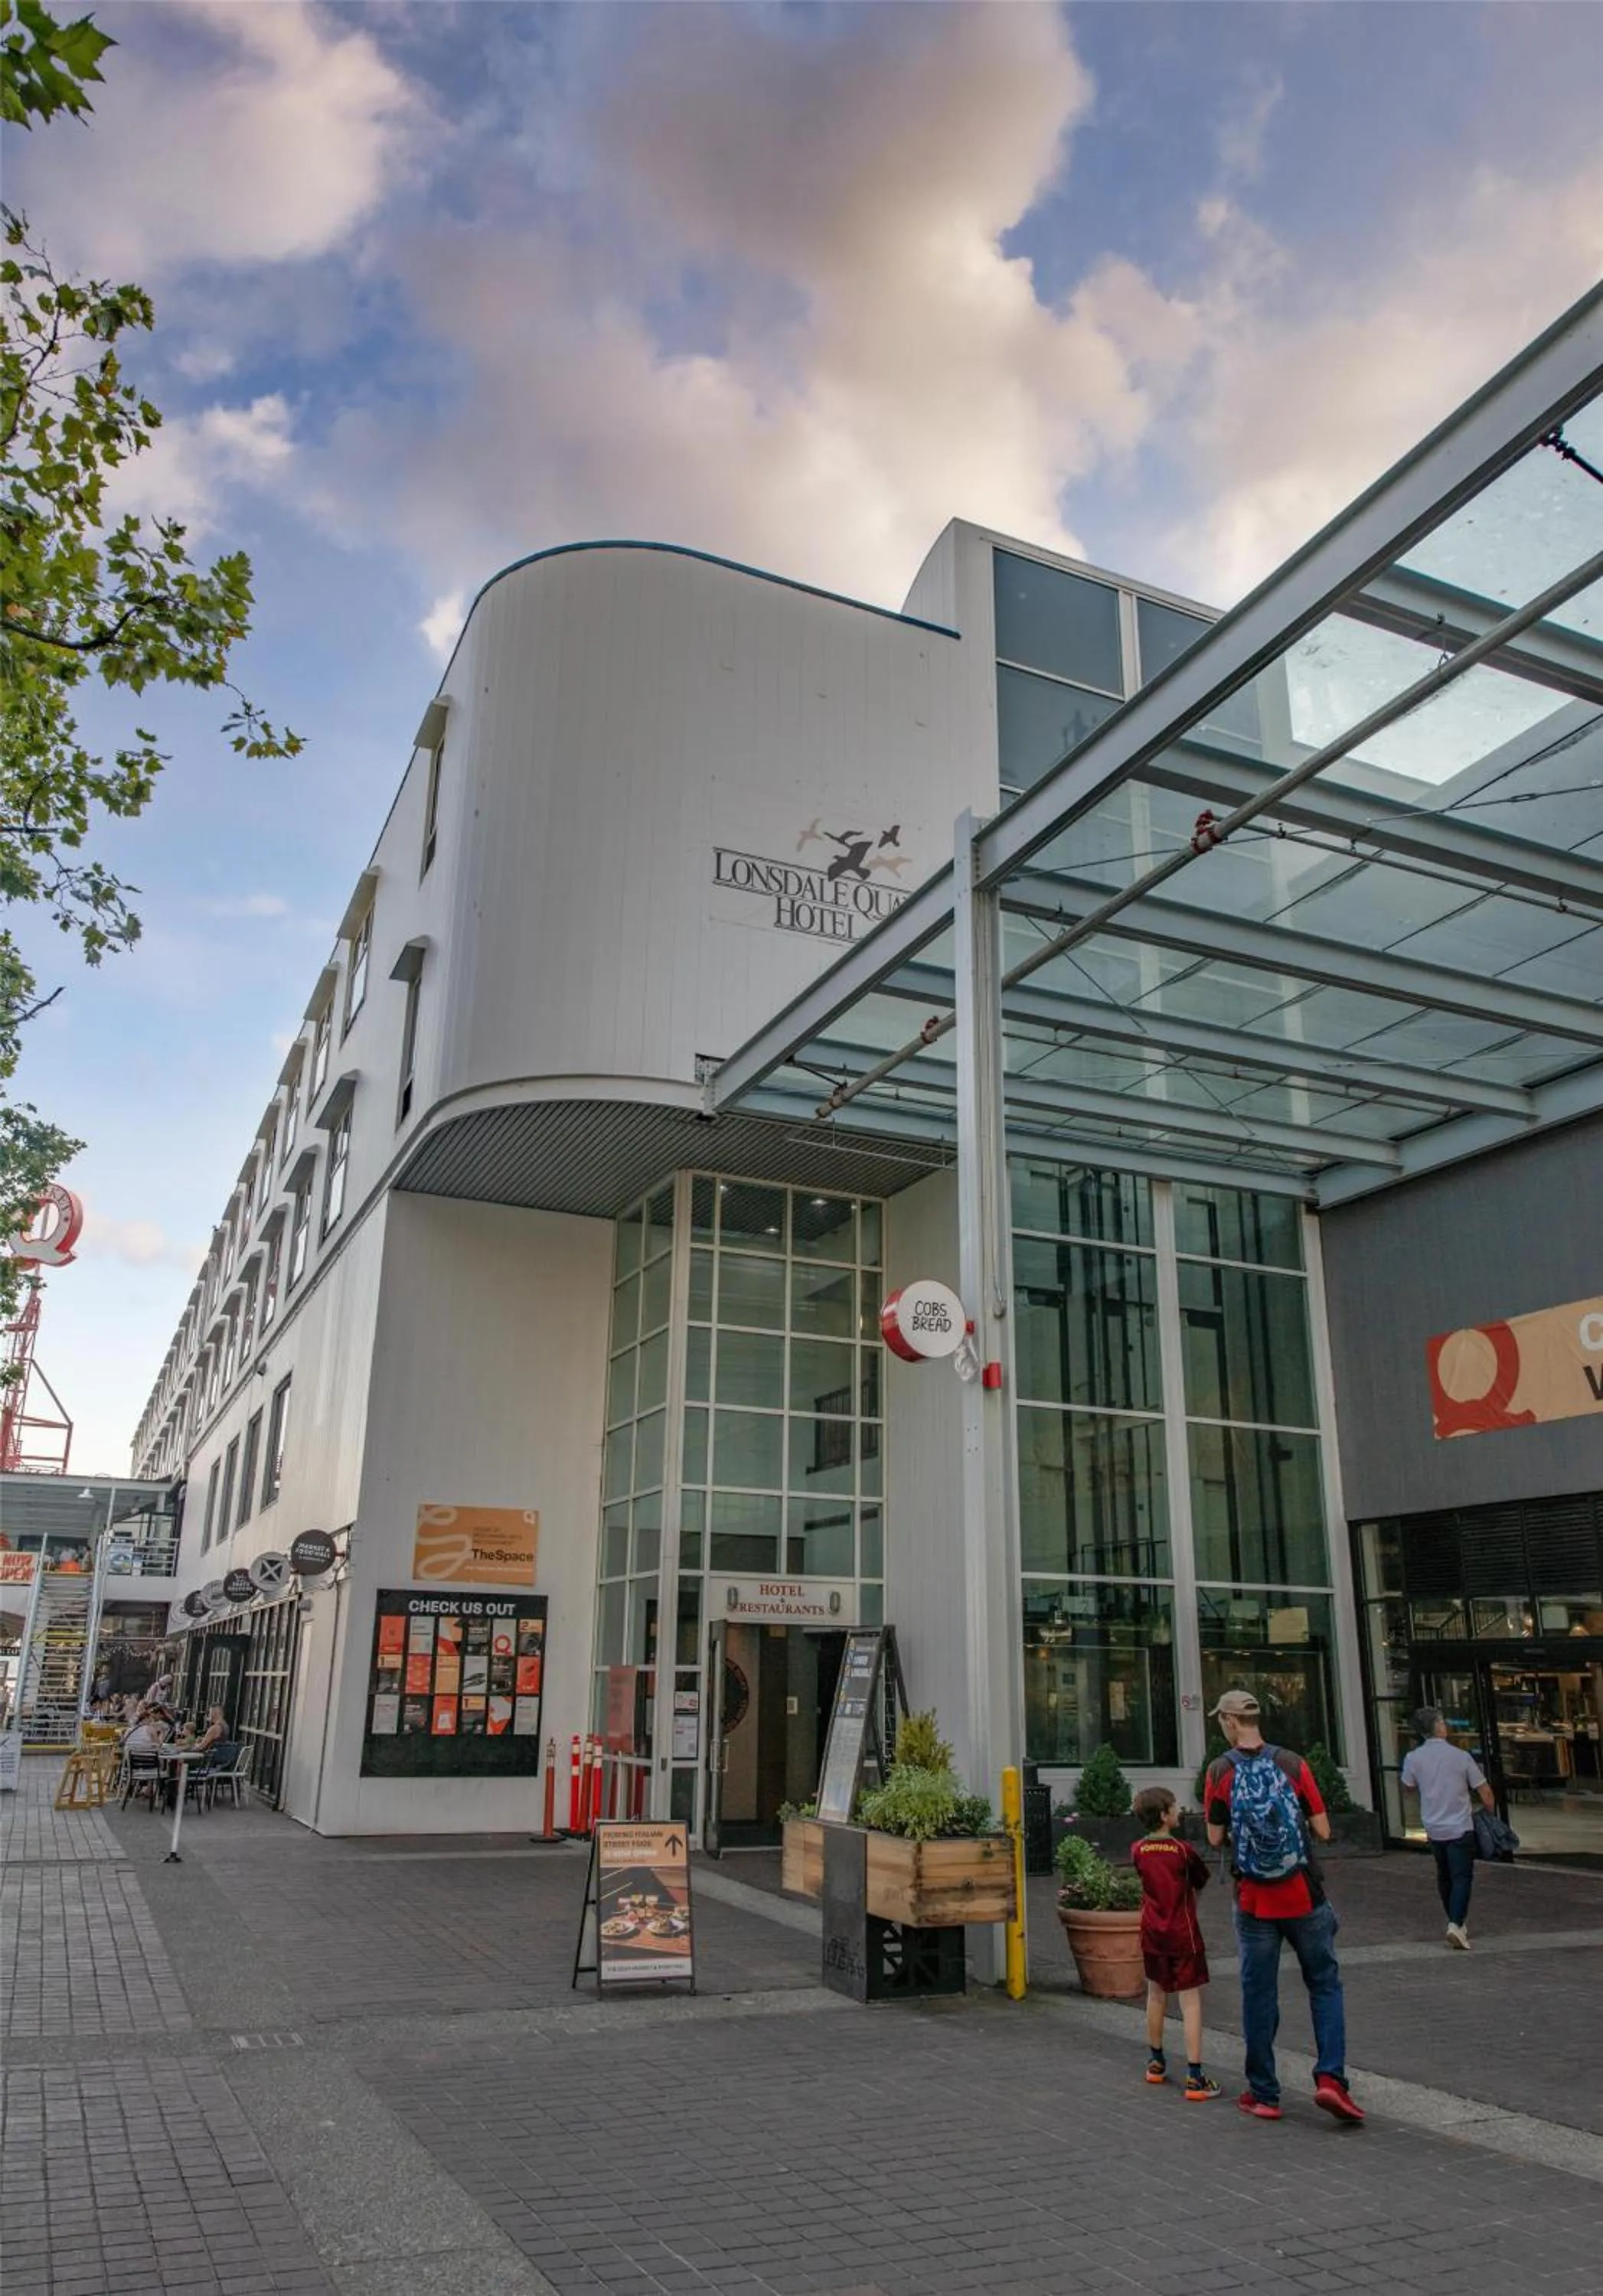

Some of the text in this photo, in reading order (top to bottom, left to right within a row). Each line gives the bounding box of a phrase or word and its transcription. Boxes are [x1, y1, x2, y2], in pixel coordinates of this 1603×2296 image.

[714, 852, 907, 921] LONSDALE QU
[775, 895, 859, 939] HOTEL
[915, 1300, 947, 1317] COBS
[912, 1316, 952, 1332] BREAD
[472, 1548, 534, 1563] TheSpace
[759, 1583, 805, 1596] HOTEL
[408, 1600, 515, 1616] CHECK US OUT
[739, 1603, 824, 1616] RESTAURANTS
